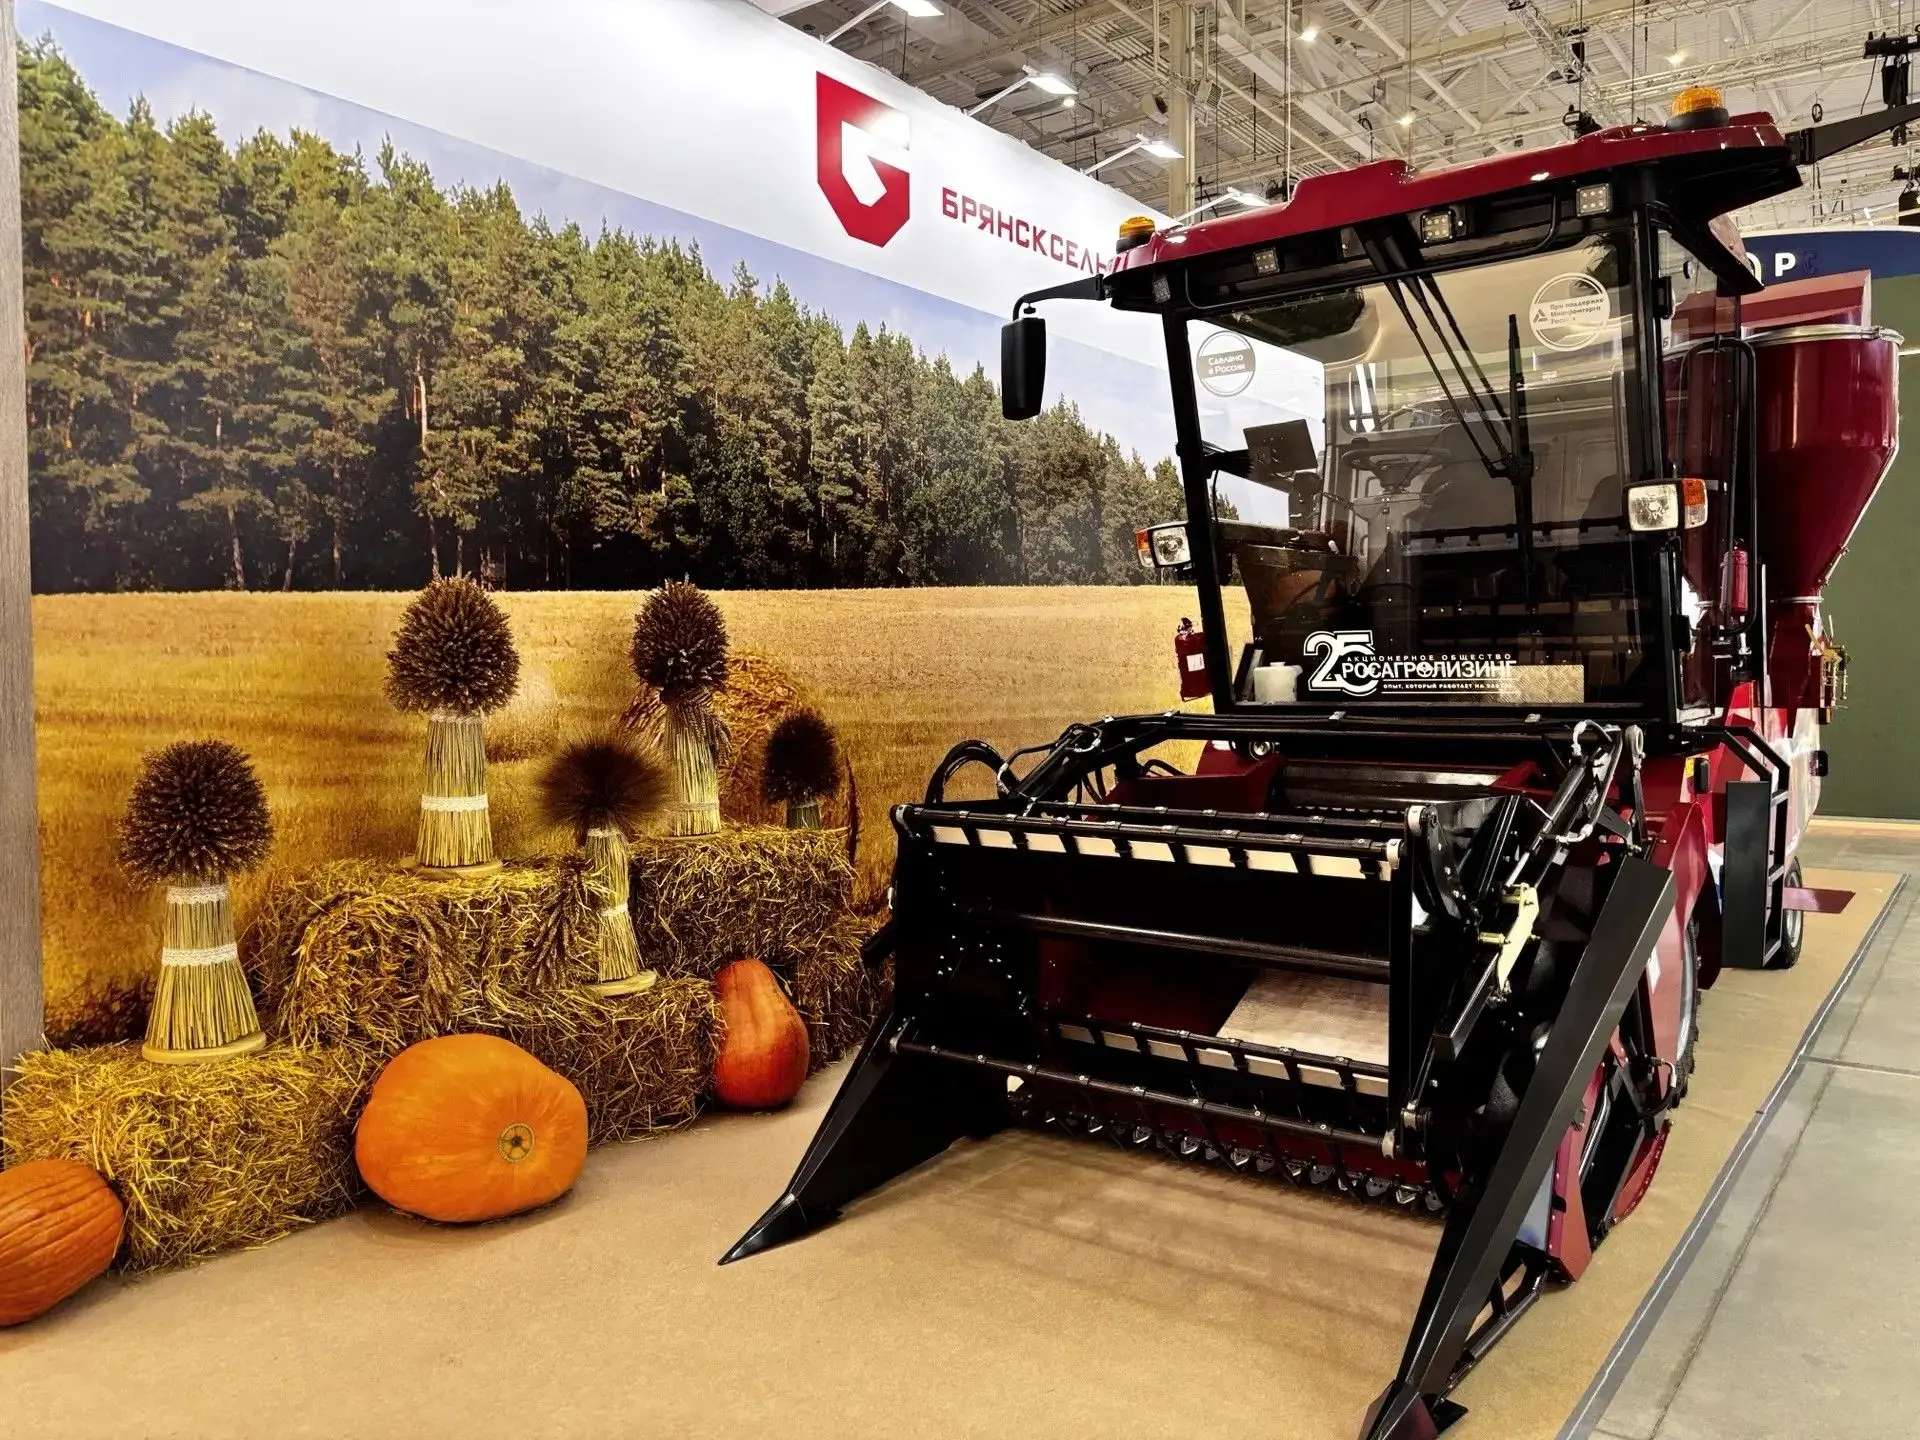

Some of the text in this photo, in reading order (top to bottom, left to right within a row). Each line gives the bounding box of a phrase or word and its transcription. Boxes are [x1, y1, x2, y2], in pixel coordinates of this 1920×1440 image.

[1208, 354, 1244, 366] Сделано
[1215, 363, 1246, 373] России
[1303, 630, 1379, 697] 25
[1346, 653, 1512, 662] АКЦИОНЕРНОЕ ОБЩЕСТВО
[1341, 660, 1517, 679] РОСАГРОЛИЗИНГ
